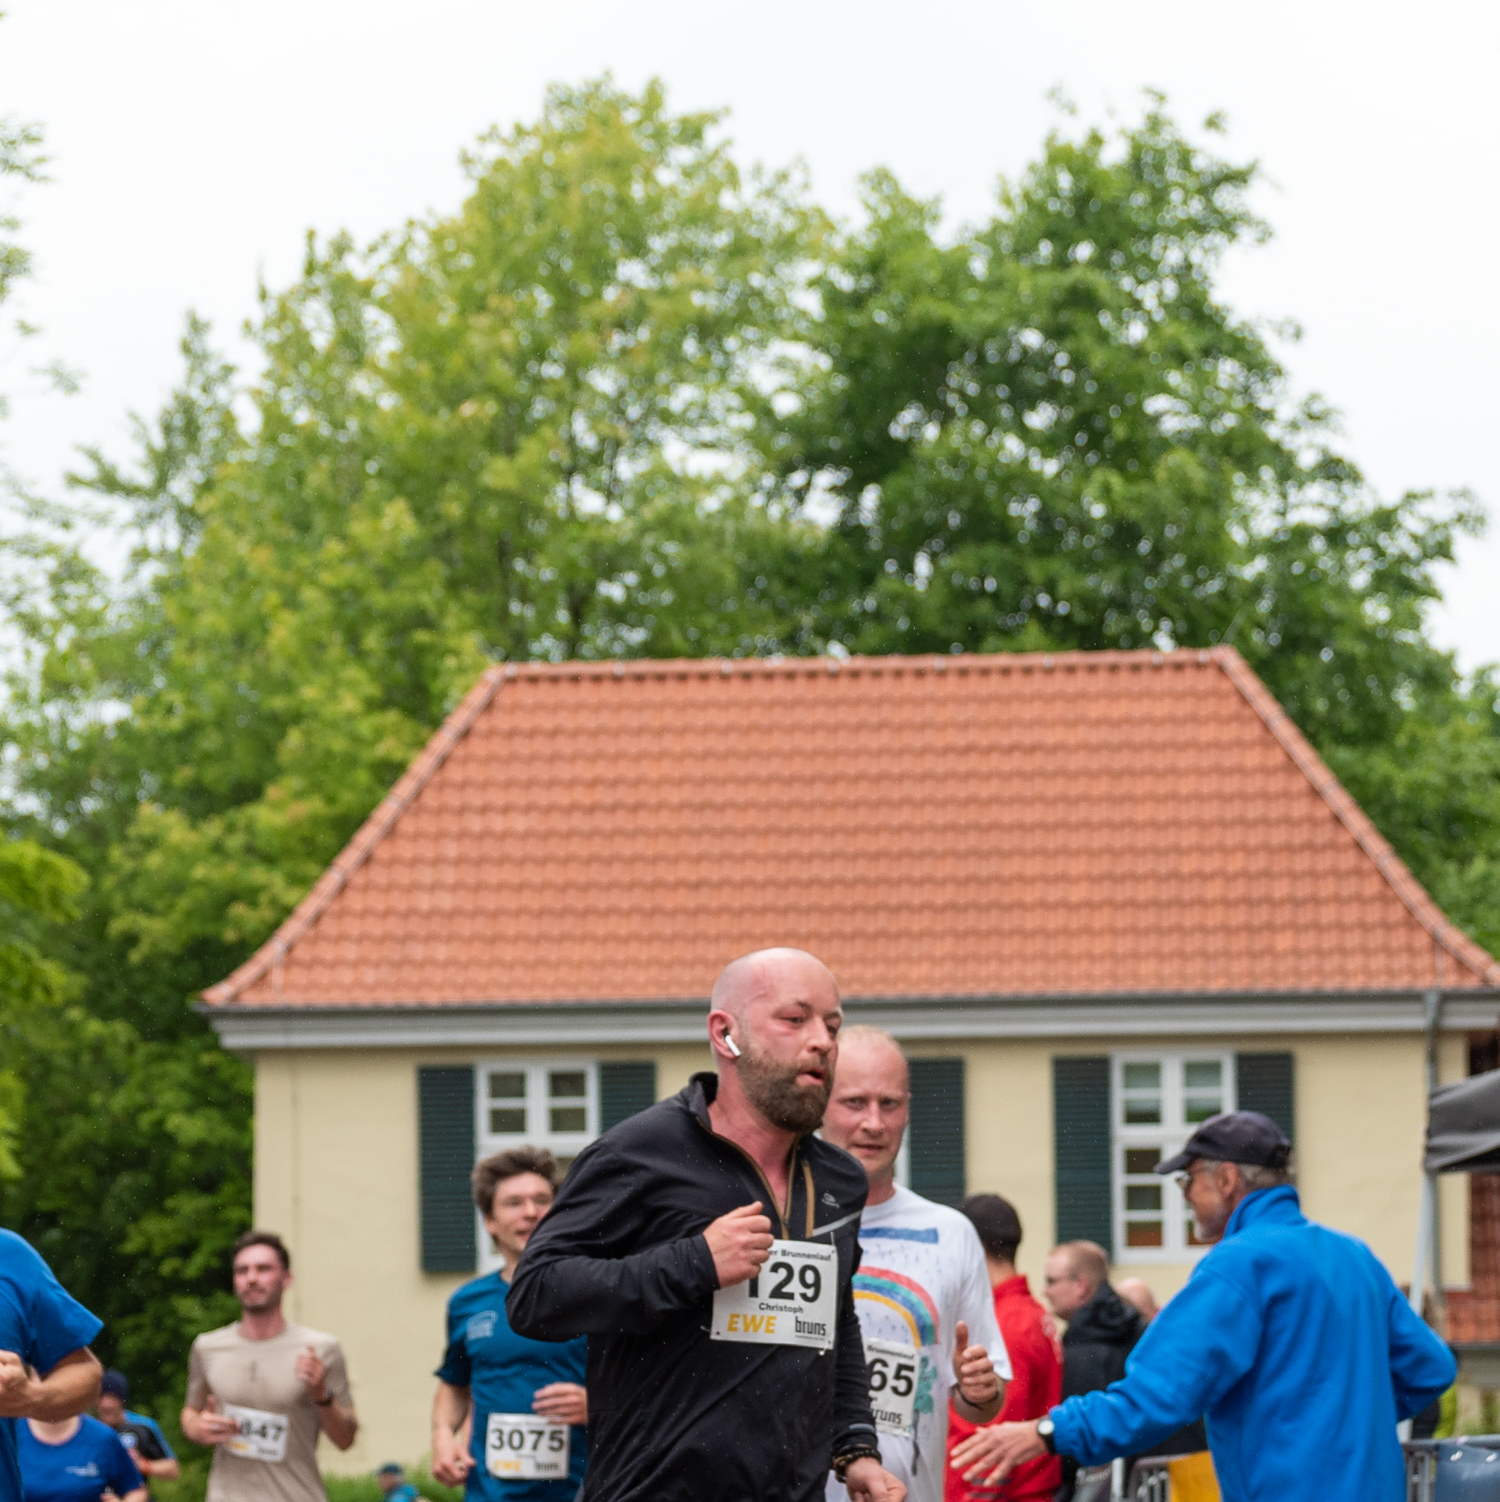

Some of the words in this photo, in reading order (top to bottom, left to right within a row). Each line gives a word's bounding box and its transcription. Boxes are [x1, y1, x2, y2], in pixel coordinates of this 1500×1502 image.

[781, 1248, 831, 1261] Brunnenlauf
[758, 1302, 804, 1315] Christoph
[727, 1313, 777, 1334] EWE
[795, 1315, 827, 1337] bruns
[867, 1357, 915, 1397] 65
[871, 1408, 902, 1425] runs
[491, 1428, 565, 1452] 3075
